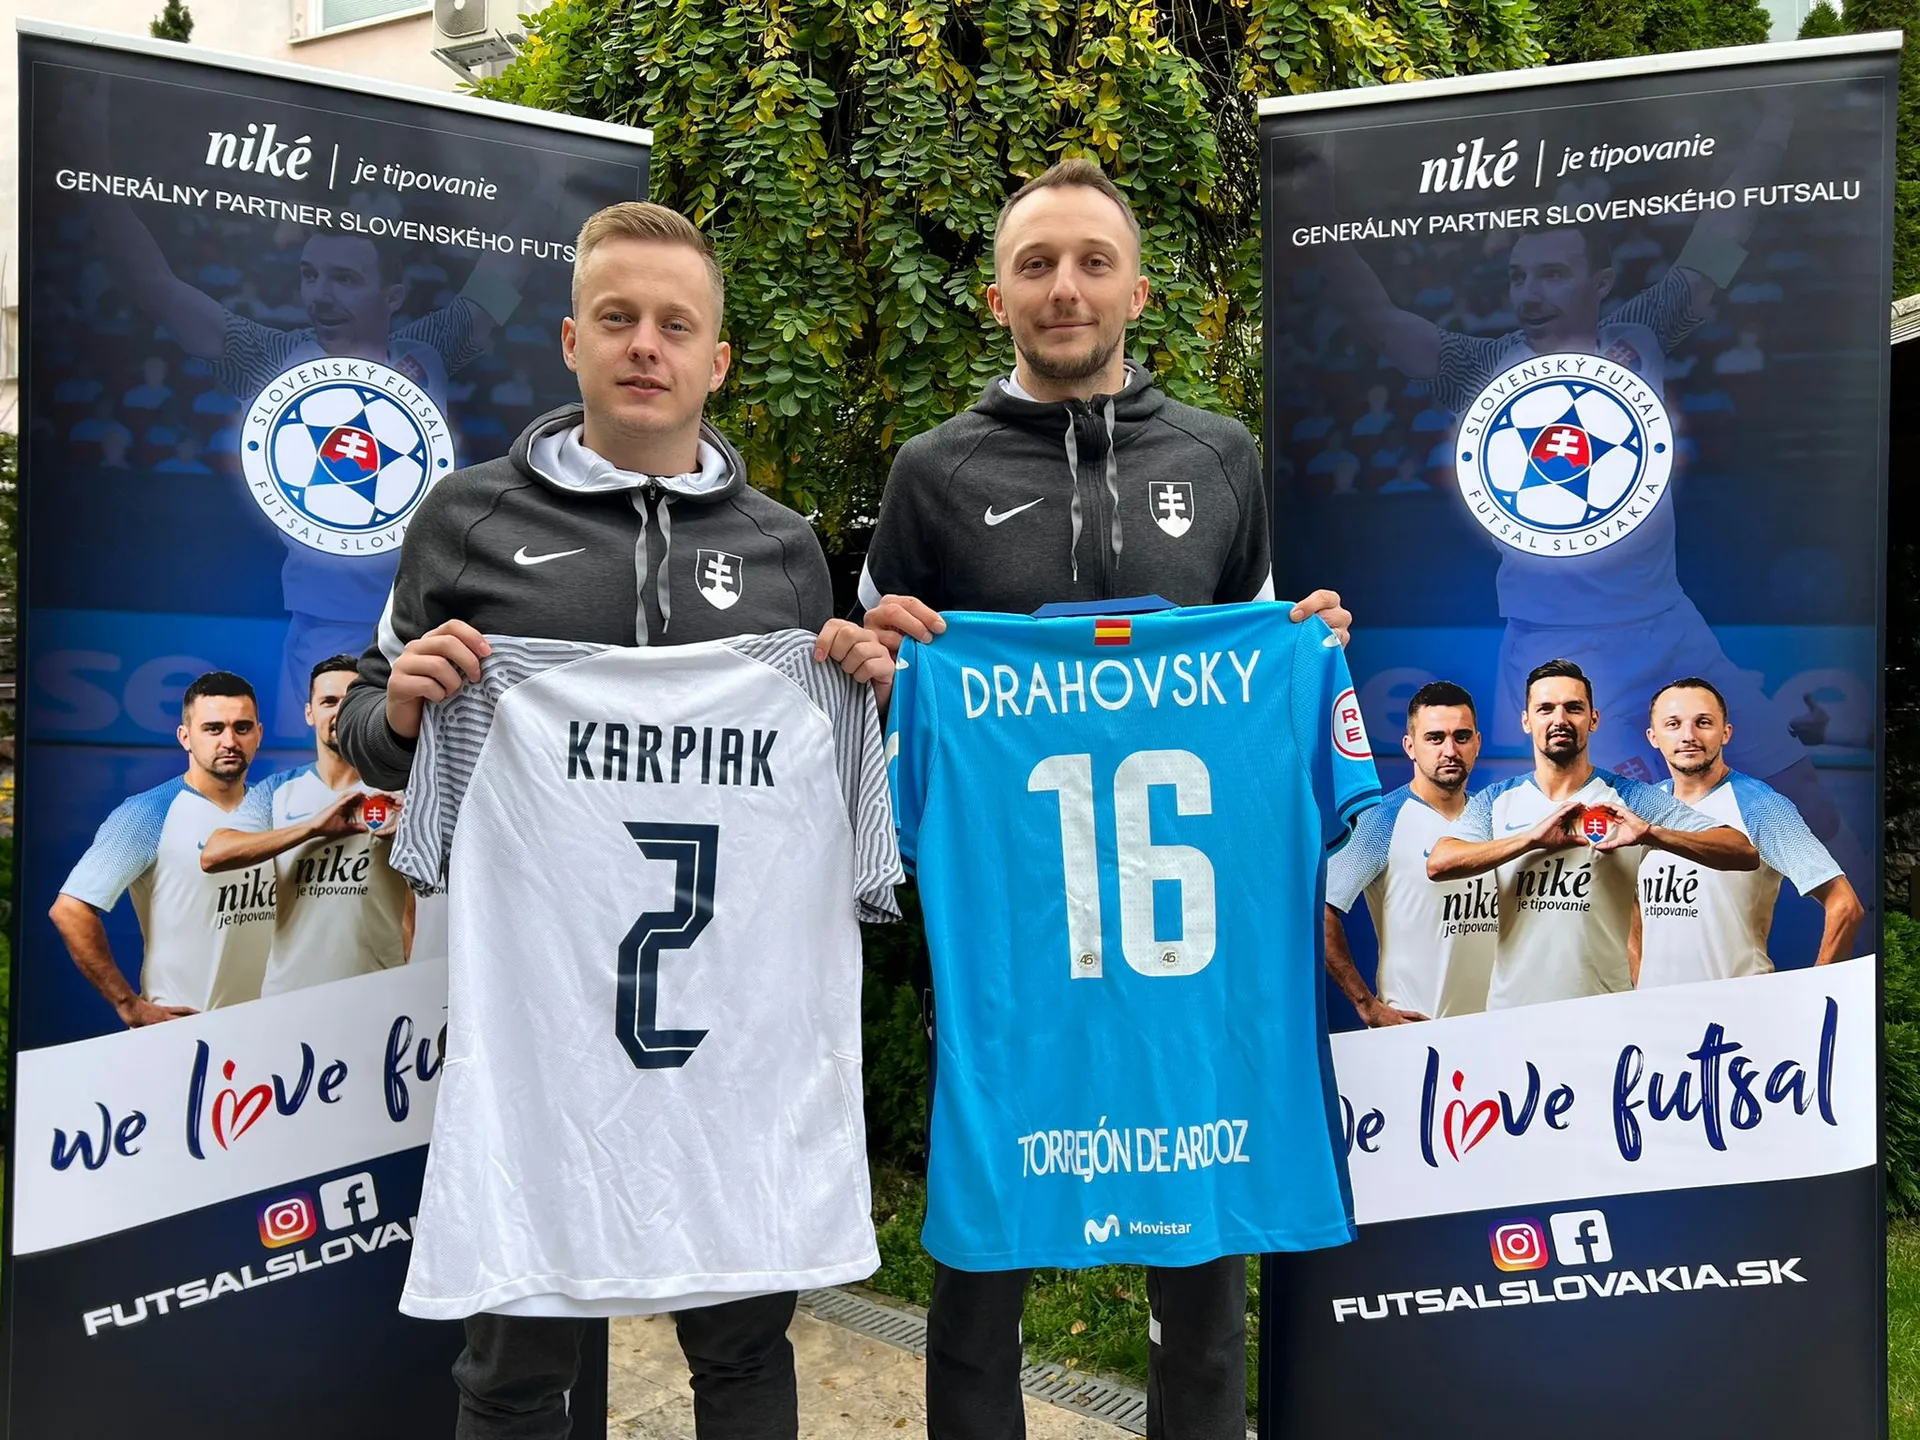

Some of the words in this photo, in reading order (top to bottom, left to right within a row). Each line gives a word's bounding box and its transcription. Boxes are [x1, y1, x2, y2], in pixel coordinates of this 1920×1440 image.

[205, 123, 312, 181] niké
[351, 157, 378, 185] je
[383, 163, 498, 200] tipovanie
[1419, 136, 1519, 193] niké
[1556, 146, 1584, 177] je
[1589, 133, 1716, 173] tipovanie
[56, 168, 209, 207] GENERÁLNY
[215, 190, 333, 228] PARTNER
[339, 211, 514, 253] SLOVENSKÉHO
[520, 238, 576, 263] FUTS
[1292, 217, 1423, 247] GENERÁLNY
[1429, 207, 1540, 234] PARTNER
[1545, 188, 1737, 225] SLOVENSKÉHO
[1743, 180, 1861, 207] FUTSALU
[253, 363, 377, 427] SLOVENSKÝ
[384, 376, 444, 444] FUTSAL
[1466, 357, 1586, 436] SLOVENSKÝ
[1594, 365, 1660, 428] FUTSAL
[254, 481, 324, 545] FUTSAL
[1469, 489, 1537, 548] FUTSAL
[1554, 482, 1660, 551] SLOVAKIA
[961, 649, 1261, 720] DRAHOVSKY
[567, 720, 779, 787] KARPIAK
[294, 844, 370, 883] niké
[295, 884, 307, 898] je
[309, 883, 369, 898] tipovanie
[1027, 749, 1217, 980] 16
[1515, 857, 1592, 898] niké
[218, 913, 232, 930] je
[1444, 922, 1457, 938] je
[1516, 898, 1529, 914] je
[1530, 898, 1591, 913] tipovanie
[1650, 904, 1699, 918] tipovanie
[615, 821, 720, 1069] 2
[50, 1101, 147, 1171] we
[186, 1039, 348, 1160] love
[1420, 1045, 1575, 1168] love
[1612, 995, 1838, 1162] futsal
[1017, 1115, 1131, 1183] TORREJÓN
[1136, 1128, 1170, 1172] DE
[1173, 1119, 1250, 1171] ARDOZ
[1129, 1221, 1192, 1235] Movistar
[82, 1215, 417, 1337] FUTSALSLOVA
[1332, 1257, 1807, 1323] FUTSALSLOVAKIA.SK
